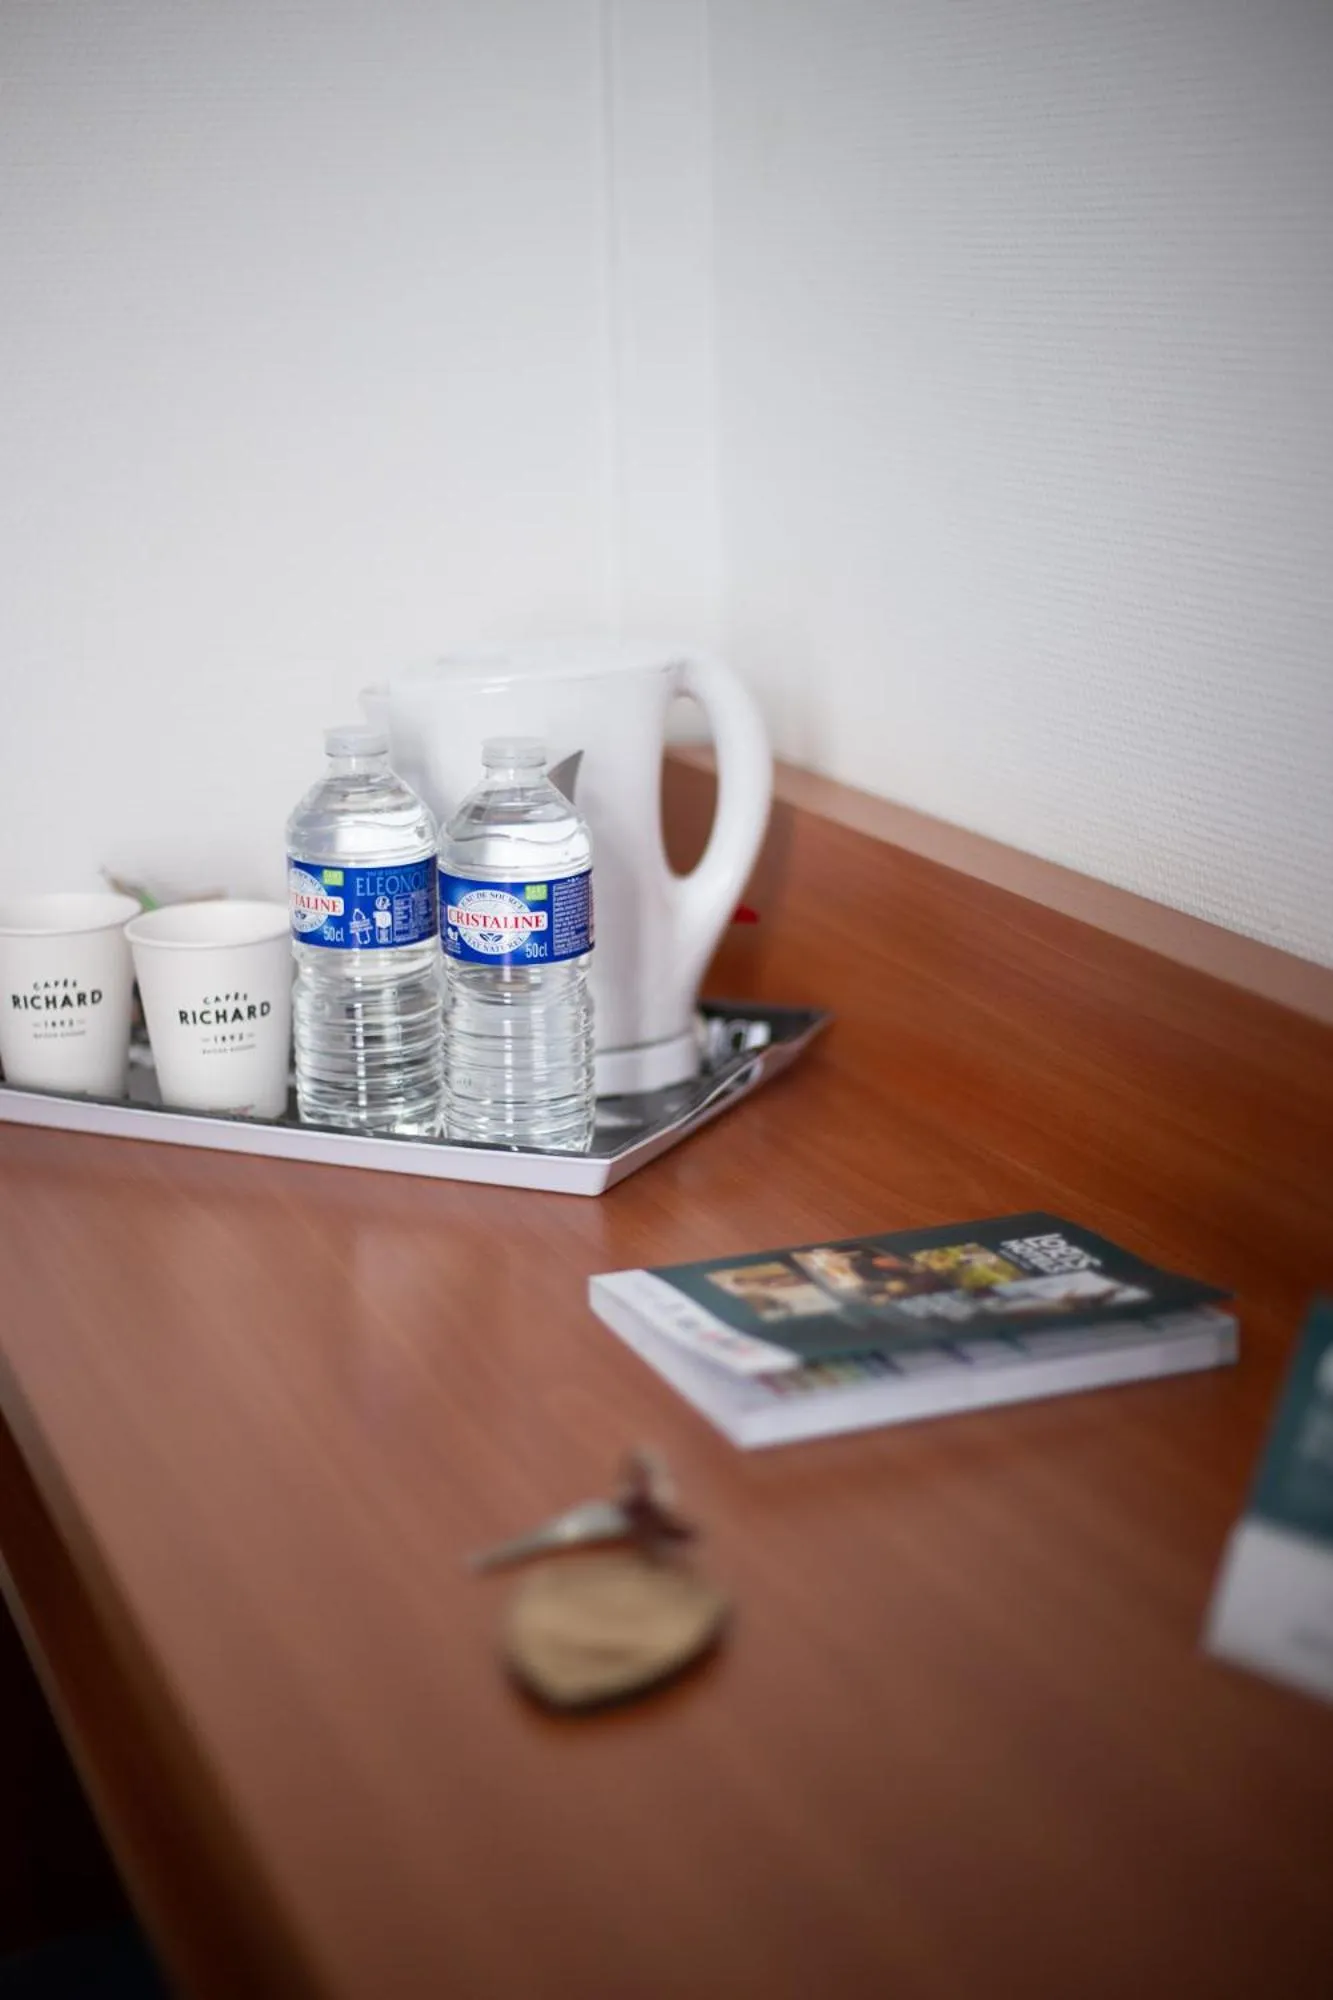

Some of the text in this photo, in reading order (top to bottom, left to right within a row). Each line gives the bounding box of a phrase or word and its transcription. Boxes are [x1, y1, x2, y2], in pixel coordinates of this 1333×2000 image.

[449, 908, 546, 930] CRISTALINE
[525, 943, 548, 958] 50cl
[11, 989, 103, 1010] RICHARD
[178, 1001, 271, 1025] RICHARD
